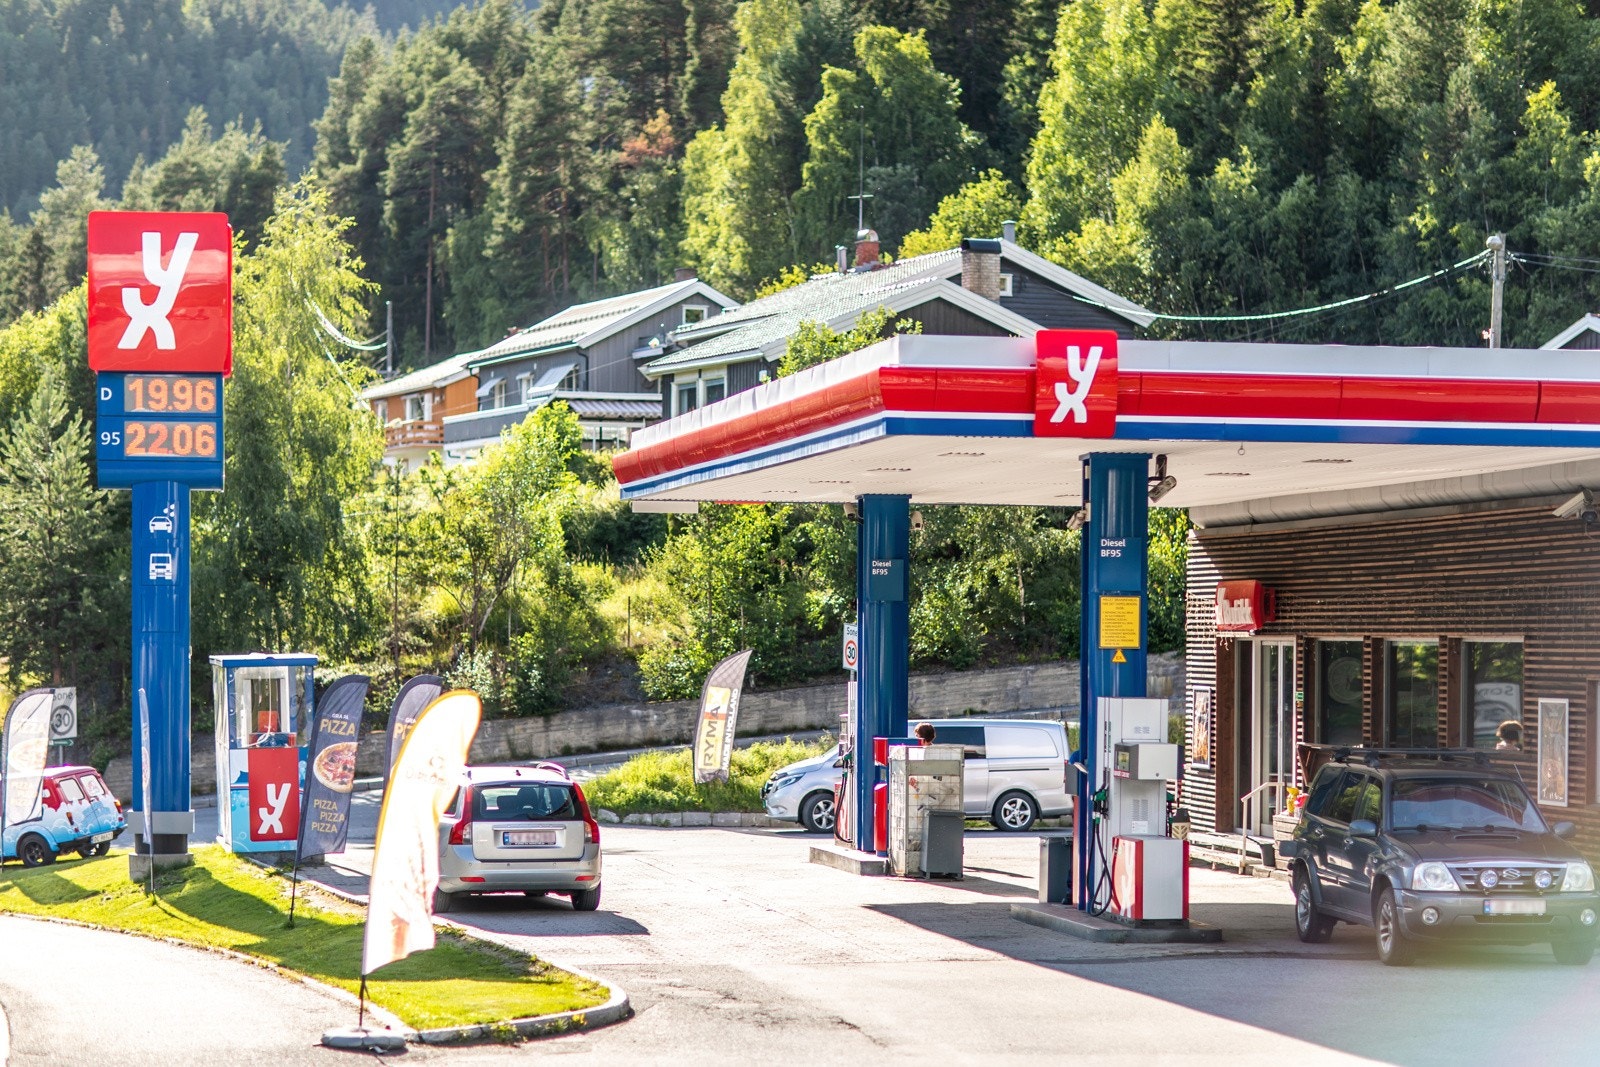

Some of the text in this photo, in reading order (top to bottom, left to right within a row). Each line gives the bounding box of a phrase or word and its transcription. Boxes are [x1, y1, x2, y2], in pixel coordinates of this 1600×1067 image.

[100, 378, 216, 411] D 19.96
[100, 422, 216, 455] 95 22.06
[1100, 538, 1126, 547] Diesel
[1100, 549, 1122, 557] BF95
[847, 646, 856, 659] 30
[727, 688, 739, 732] HOLLAND
[55, 713, 71, 728] 30
[319, 718, 356, 737] PIZZA
[313, 799, 338, 811] PIZZA
[319, 811, 345, 823] PIZZA
[311, 821, 338, 834] PIZZA
